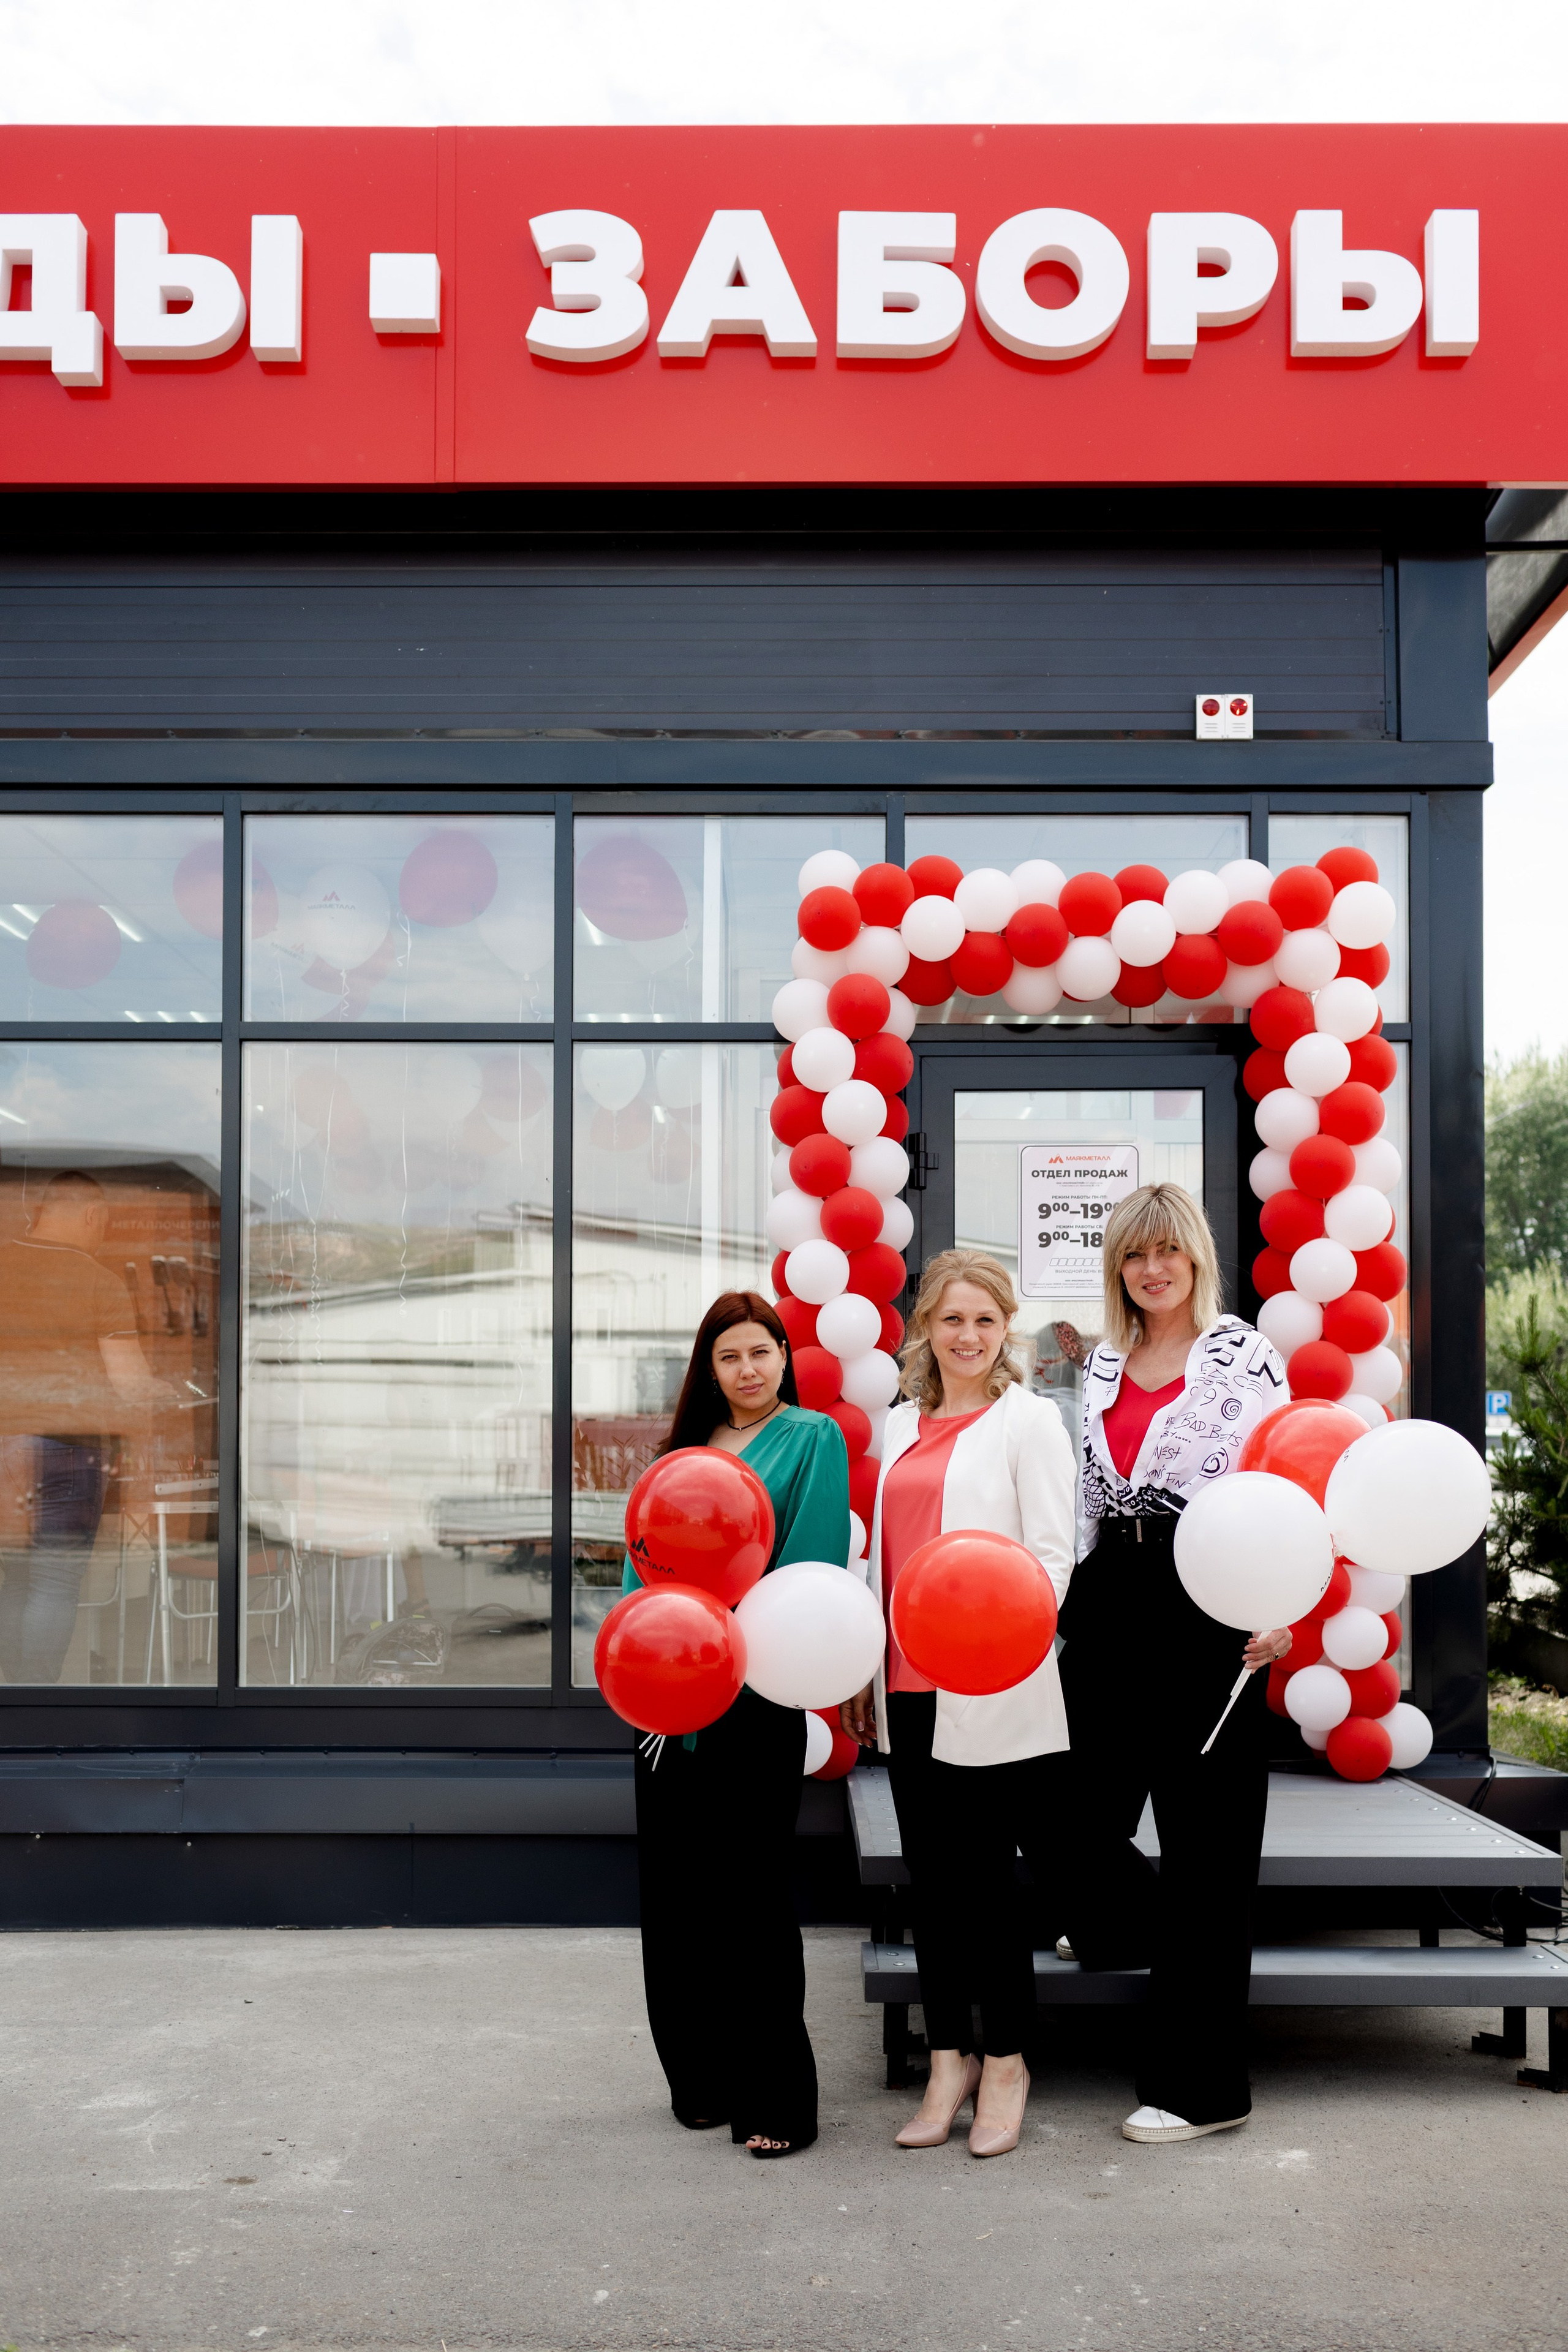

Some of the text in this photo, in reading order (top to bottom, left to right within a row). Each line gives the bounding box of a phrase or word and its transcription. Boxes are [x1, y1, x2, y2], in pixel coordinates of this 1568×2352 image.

[526, 207, 1479, 363] ЗАБОРЫ
[1031, 1169, 1128, 1178] ОТДЕЛ ПРОДАЖ
[1493, 1393, 1507, 1414] P
[1174, 1412, 1206, 1432] BAD
